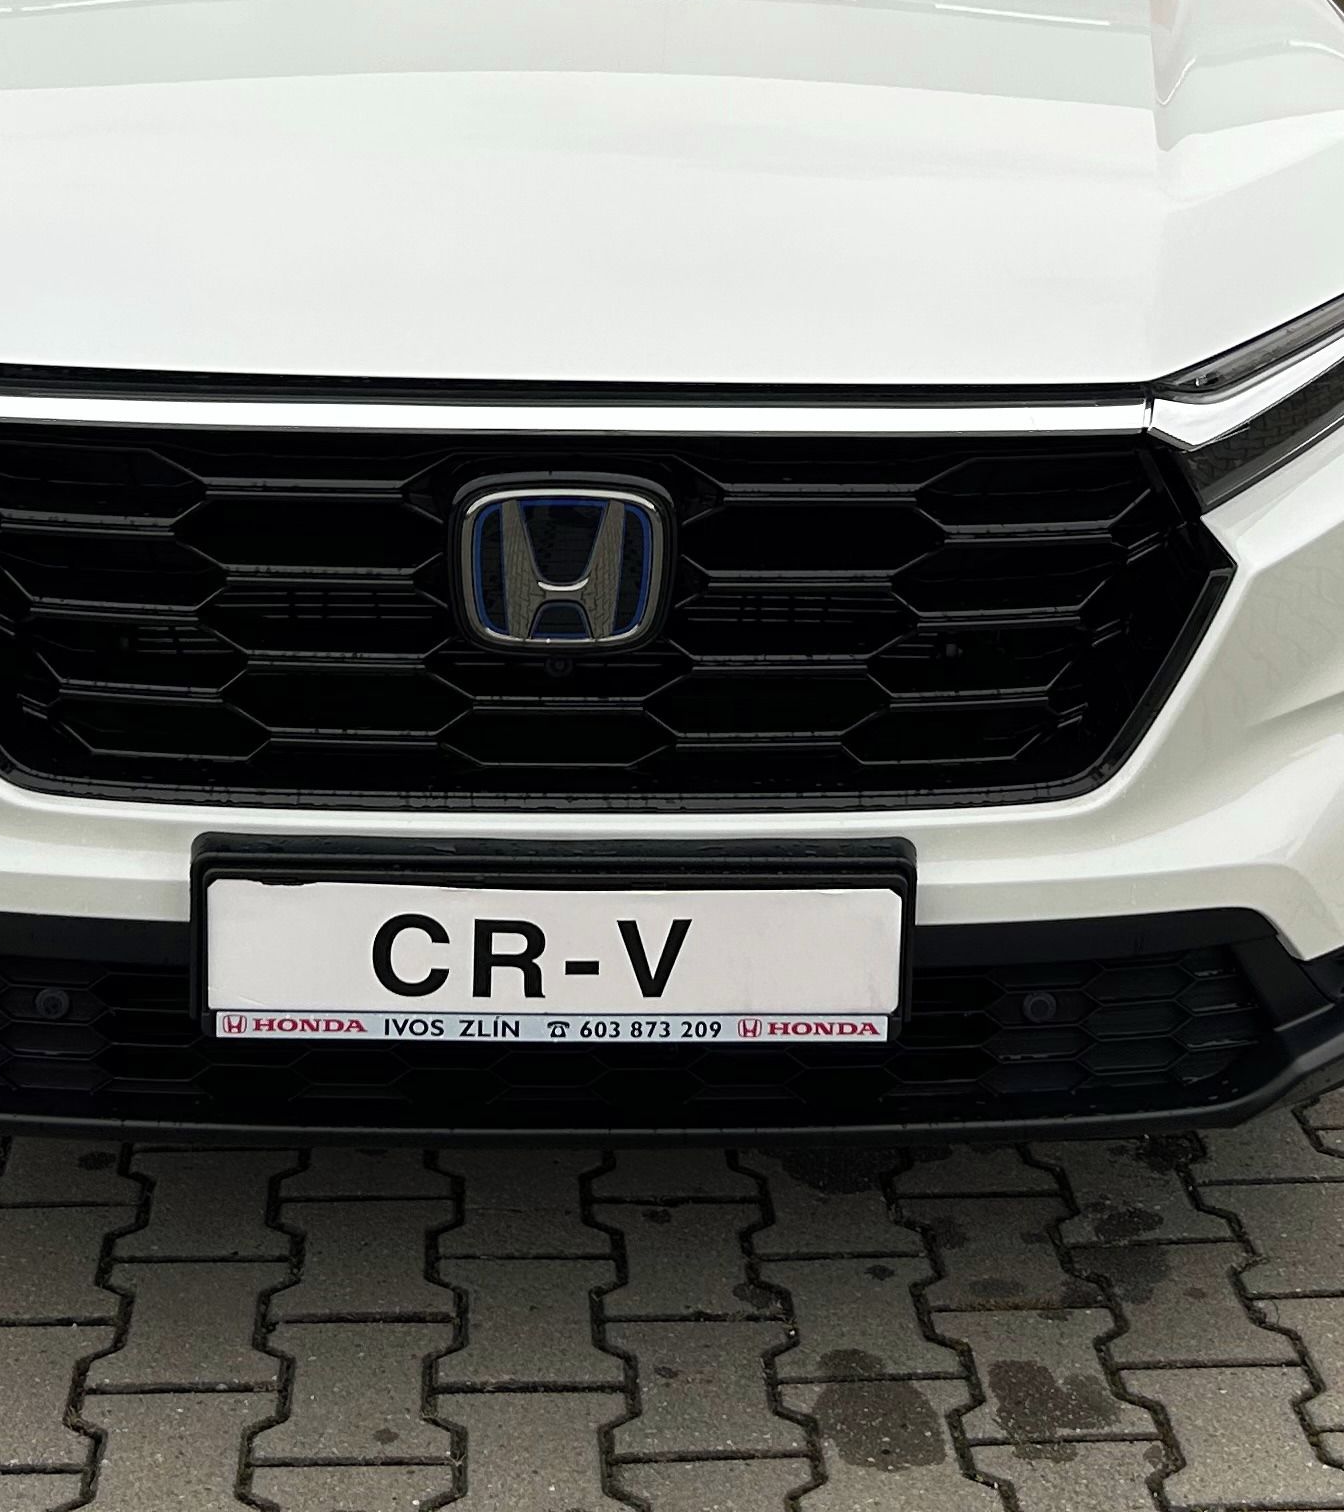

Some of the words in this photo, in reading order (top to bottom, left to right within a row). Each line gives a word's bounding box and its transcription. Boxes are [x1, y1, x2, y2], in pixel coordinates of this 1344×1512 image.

[372, 912, 693, 999] CR-V
[252, 1016, 368, 1033] HONDA
[384, 1018, 445, 1037] IVOS
[459, 1015, 521, 1038] ZLÍN
[579, 1020, 621, 1038] 603
[630, 1020, 672, 1039] 873
[680, 1020, 723, 1039] 209
[767, 1021, 881, 1036] HONDA
